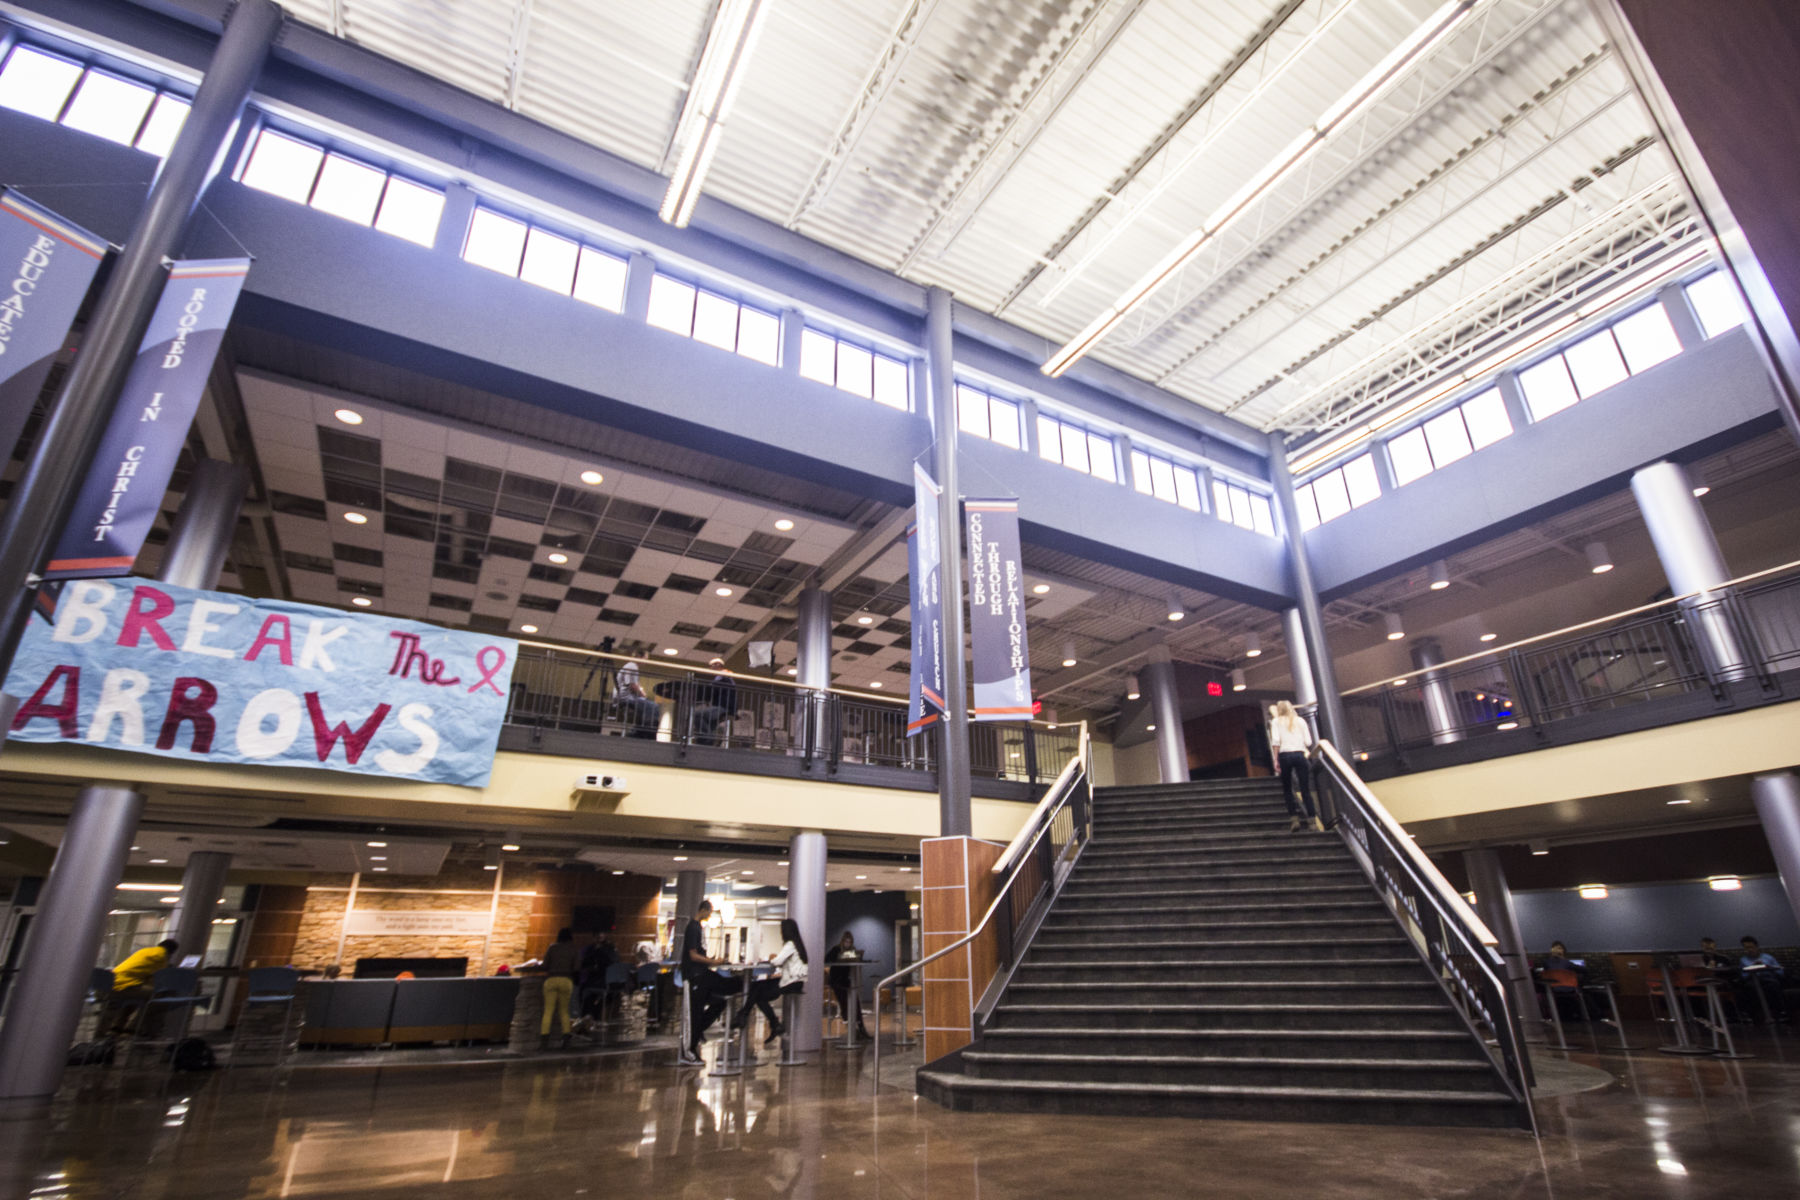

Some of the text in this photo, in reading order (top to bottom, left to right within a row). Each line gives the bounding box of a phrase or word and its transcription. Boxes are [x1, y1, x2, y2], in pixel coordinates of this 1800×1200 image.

[0, 234, 56, 355] EDUCATE
[94, 287, 207, 541] ROOTED IN CHRIST
[970, 512, 986, 606] CONNECTED
[987, 542, 1003, 616] THROUGH
[51, 579, 460, 687] BREAK The
[1005, 560, 1024, 702] RELATIONSHIPS
[8, 664, 441, 775] ARROWS
